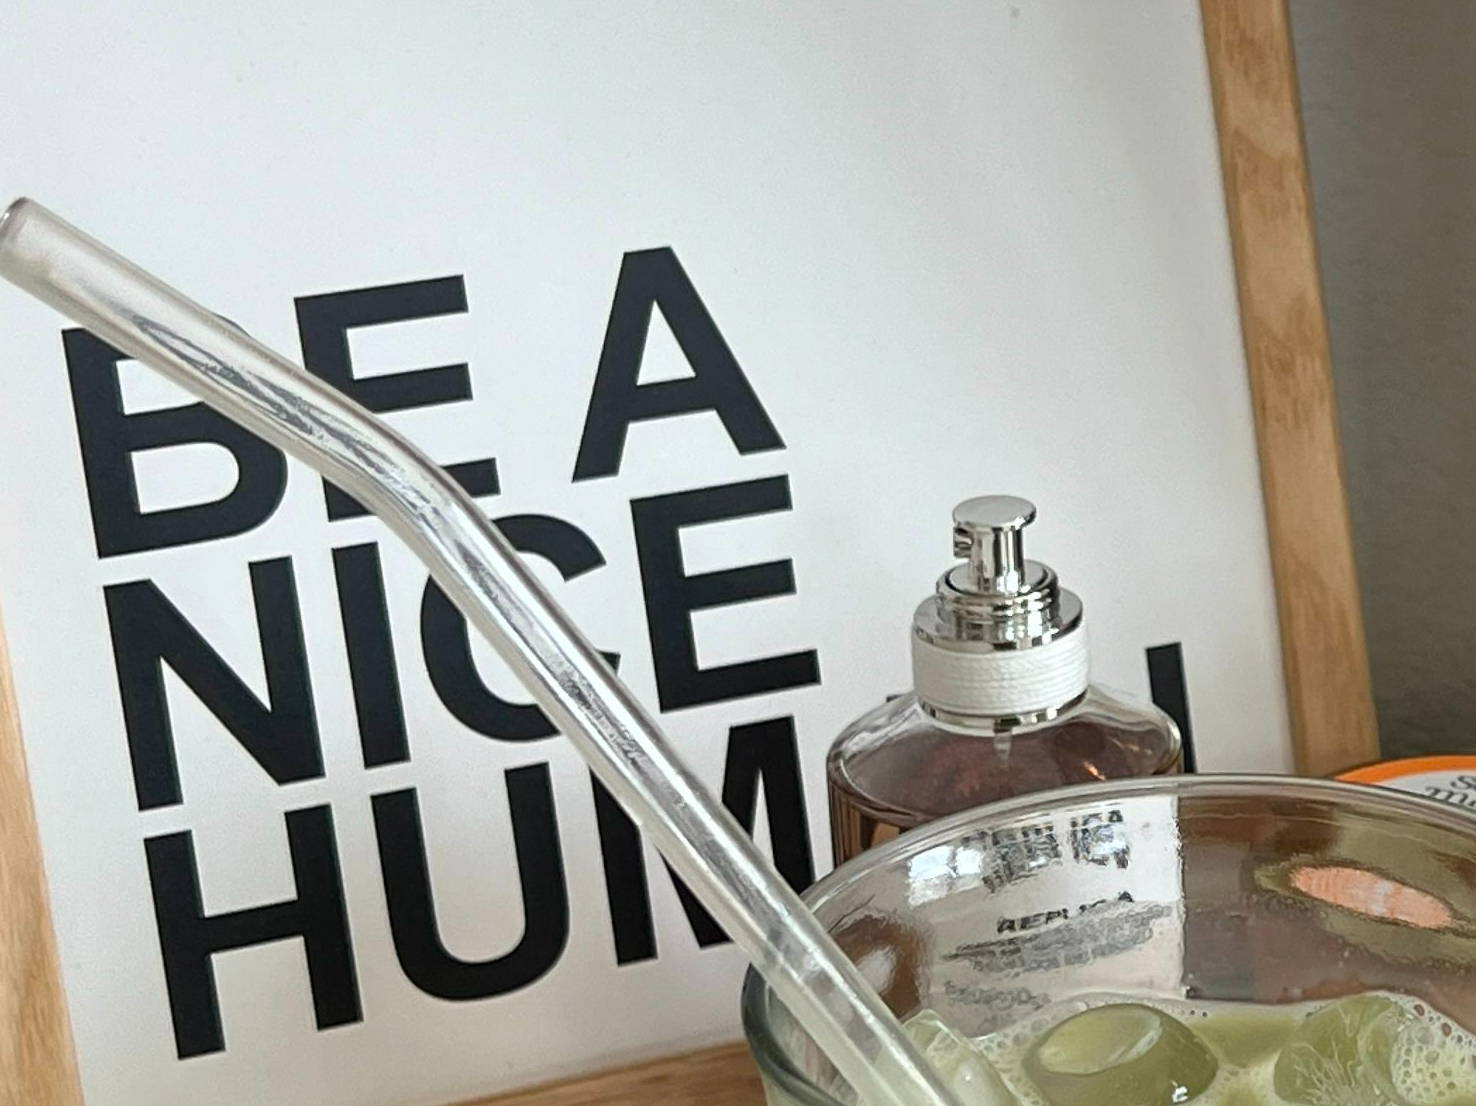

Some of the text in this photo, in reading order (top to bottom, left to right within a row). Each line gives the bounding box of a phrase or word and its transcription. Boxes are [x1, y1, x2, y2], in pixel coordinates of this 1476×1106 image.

[62, 246, 787, 560] BE A
[103, 473, 822, 812] NICE
